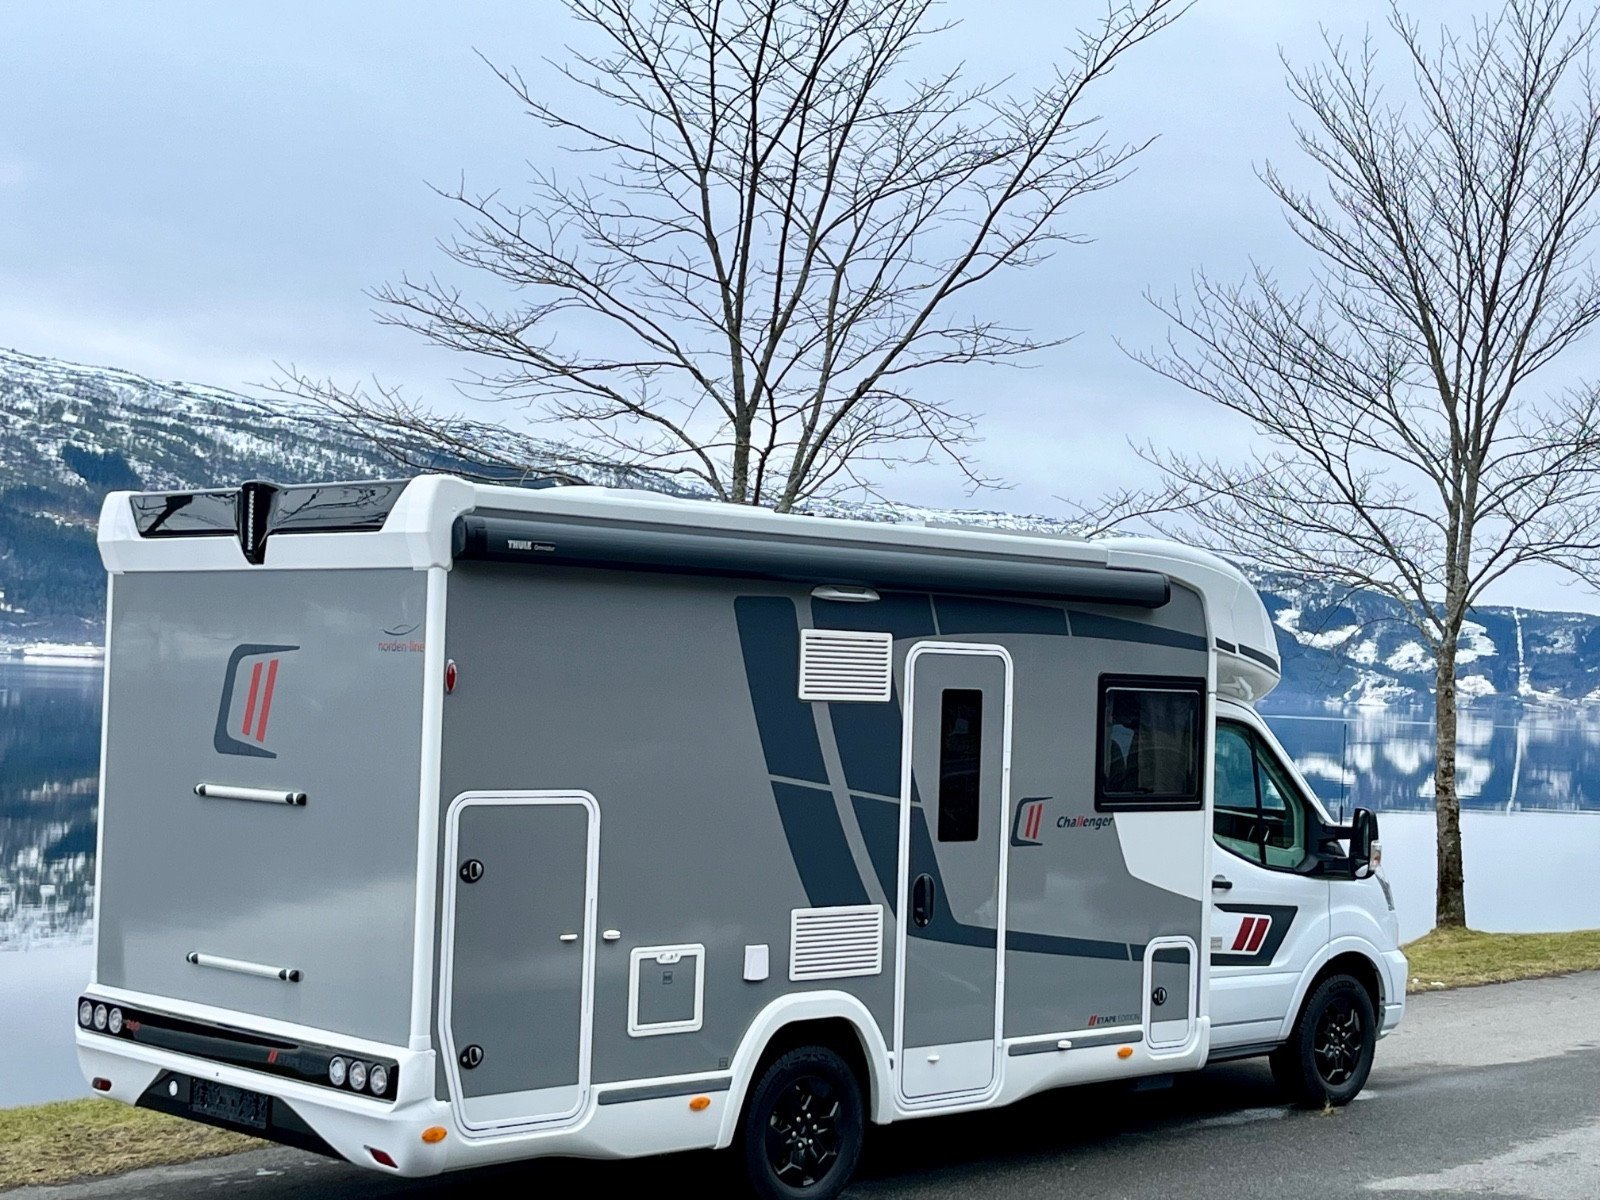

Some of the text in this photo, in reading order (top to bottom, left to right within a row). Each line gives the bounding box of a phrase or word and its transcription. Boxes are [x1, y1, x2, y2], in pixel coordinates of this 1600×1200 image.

[508, 540, 532, 550] THULE
[378, 641, 425, 652] norden-line
[1056, 815, 1114, 830] Challenger
